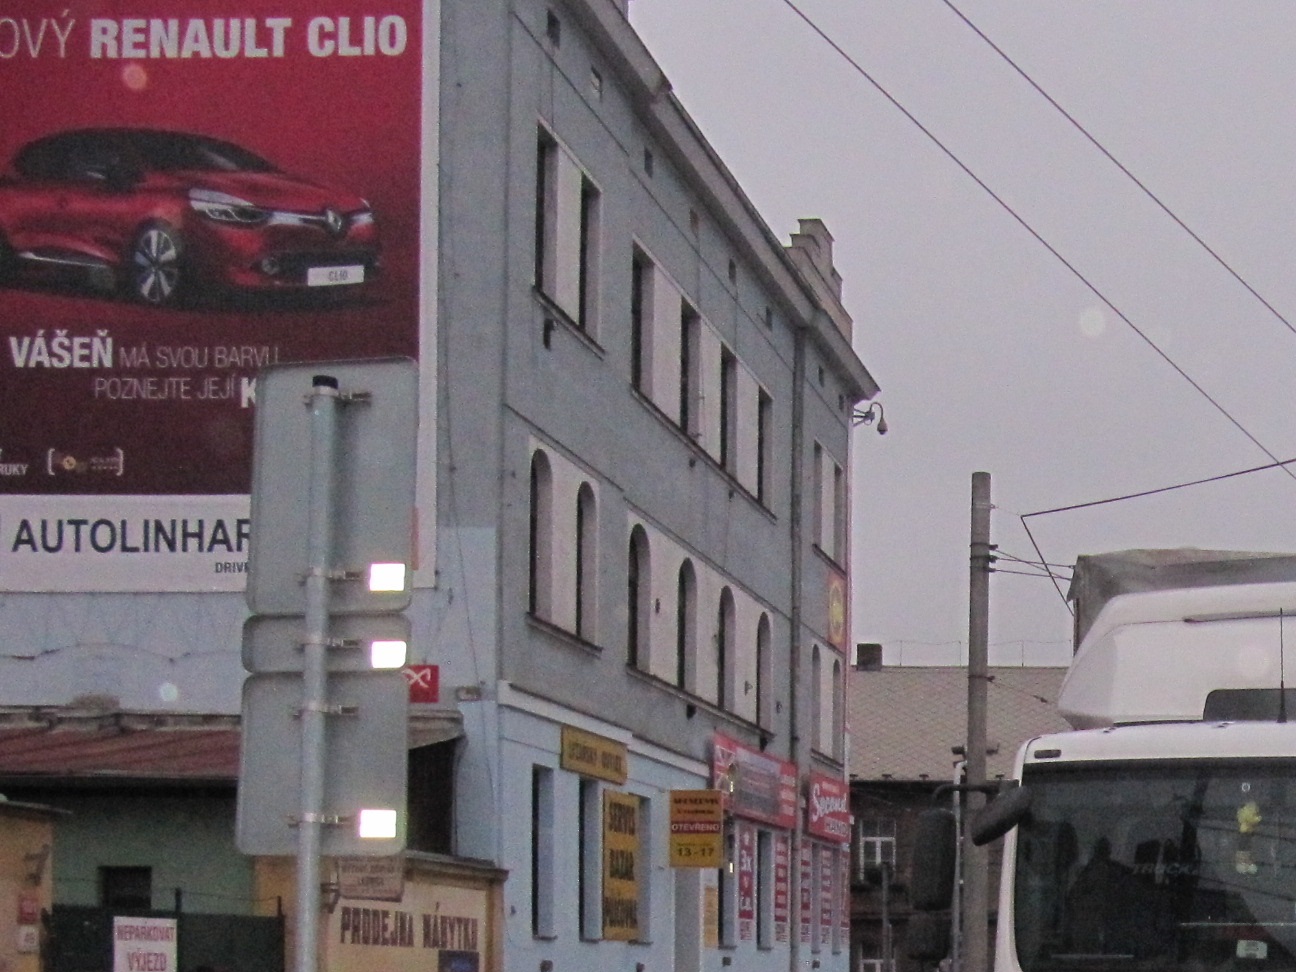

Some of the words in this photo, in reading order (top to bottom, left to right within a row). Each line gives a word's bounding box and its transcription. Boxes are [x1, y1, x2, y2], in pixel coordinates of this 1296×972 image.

[90, 17, 292, 59] RENAULT
[307, 15, 408, 58] CLIO
[10, 329, 113, 368] VÁŠEŇ
[157, 346, 209, 368] SVOU
[95, 377, 191, 400] POZNEJTE
[198, 374, 235, 400] JEJÍ
[671, 822, 720, 831] OTEVŘENO
[116, 924, 175, 942] NEPARKOVAT
[340, 906, 414, 948] PRODEJNA
[422, 902, 479, 951] NÁBYTKU
[127, 947, 167, 972] VÝJEZD
